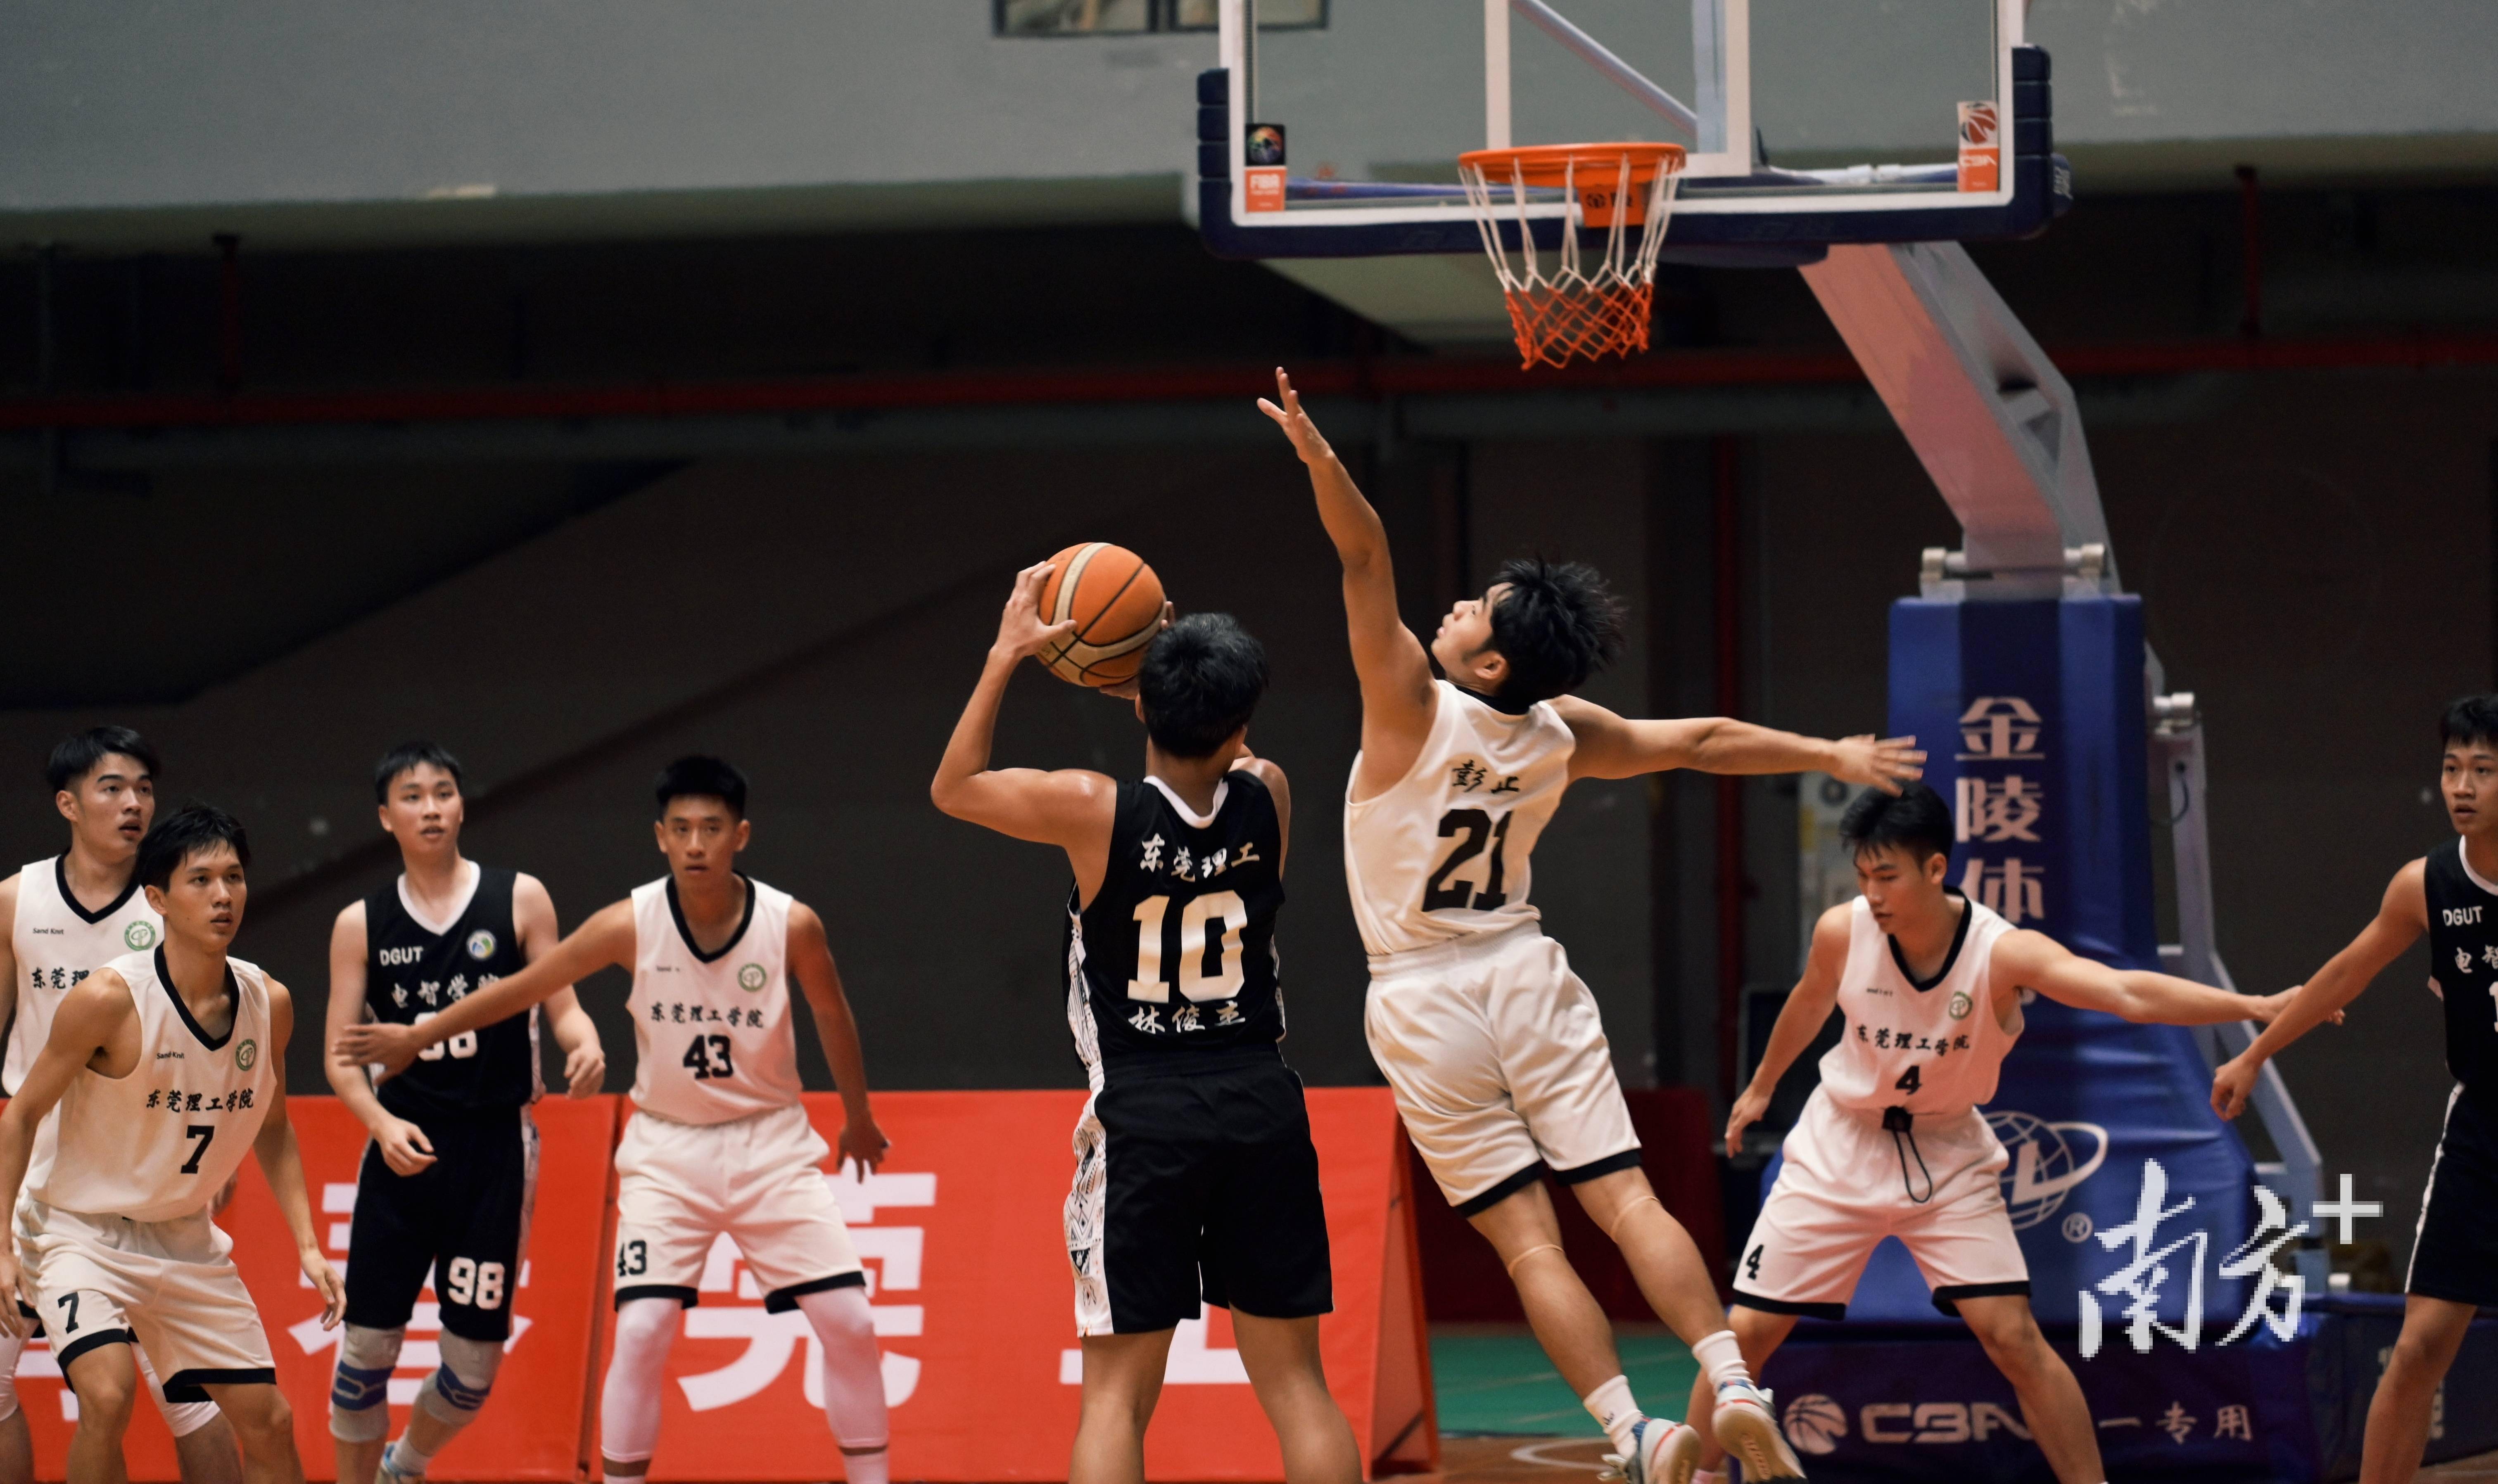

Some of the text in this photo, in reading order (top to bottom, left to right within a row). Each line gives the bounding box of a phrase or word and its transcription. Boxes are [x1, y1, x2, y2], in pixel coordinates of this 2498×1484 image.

[1140, 833, 1260, 882] 东莞理工
[1422, 808, 1513, 911] 21
[2442, 906, 2482, 927] DGUT
[380, 946, 423, 966] DGUT
[1128, 890, 1247, 1003] 10
[651, 1002, 763, 1028] 东莞理工学院
[157, 1051, 171, 1060] Sand
[683, 1035, 733, 1079] 43
[1857, 1024, 1970, 1057] 东莞理工学院
[1895, 1065, 1922, 1095] 4
[146, 1088, 254, 1113] 东莞理工学院
[180, 1125, 215, 1174] 7
[617, 1240, 647, 1277] 43
[1745, 1244, 1764, 1280] 4
[449, 1256, 504, 1310] 98
[57, 1292, 79, 1334] 7
